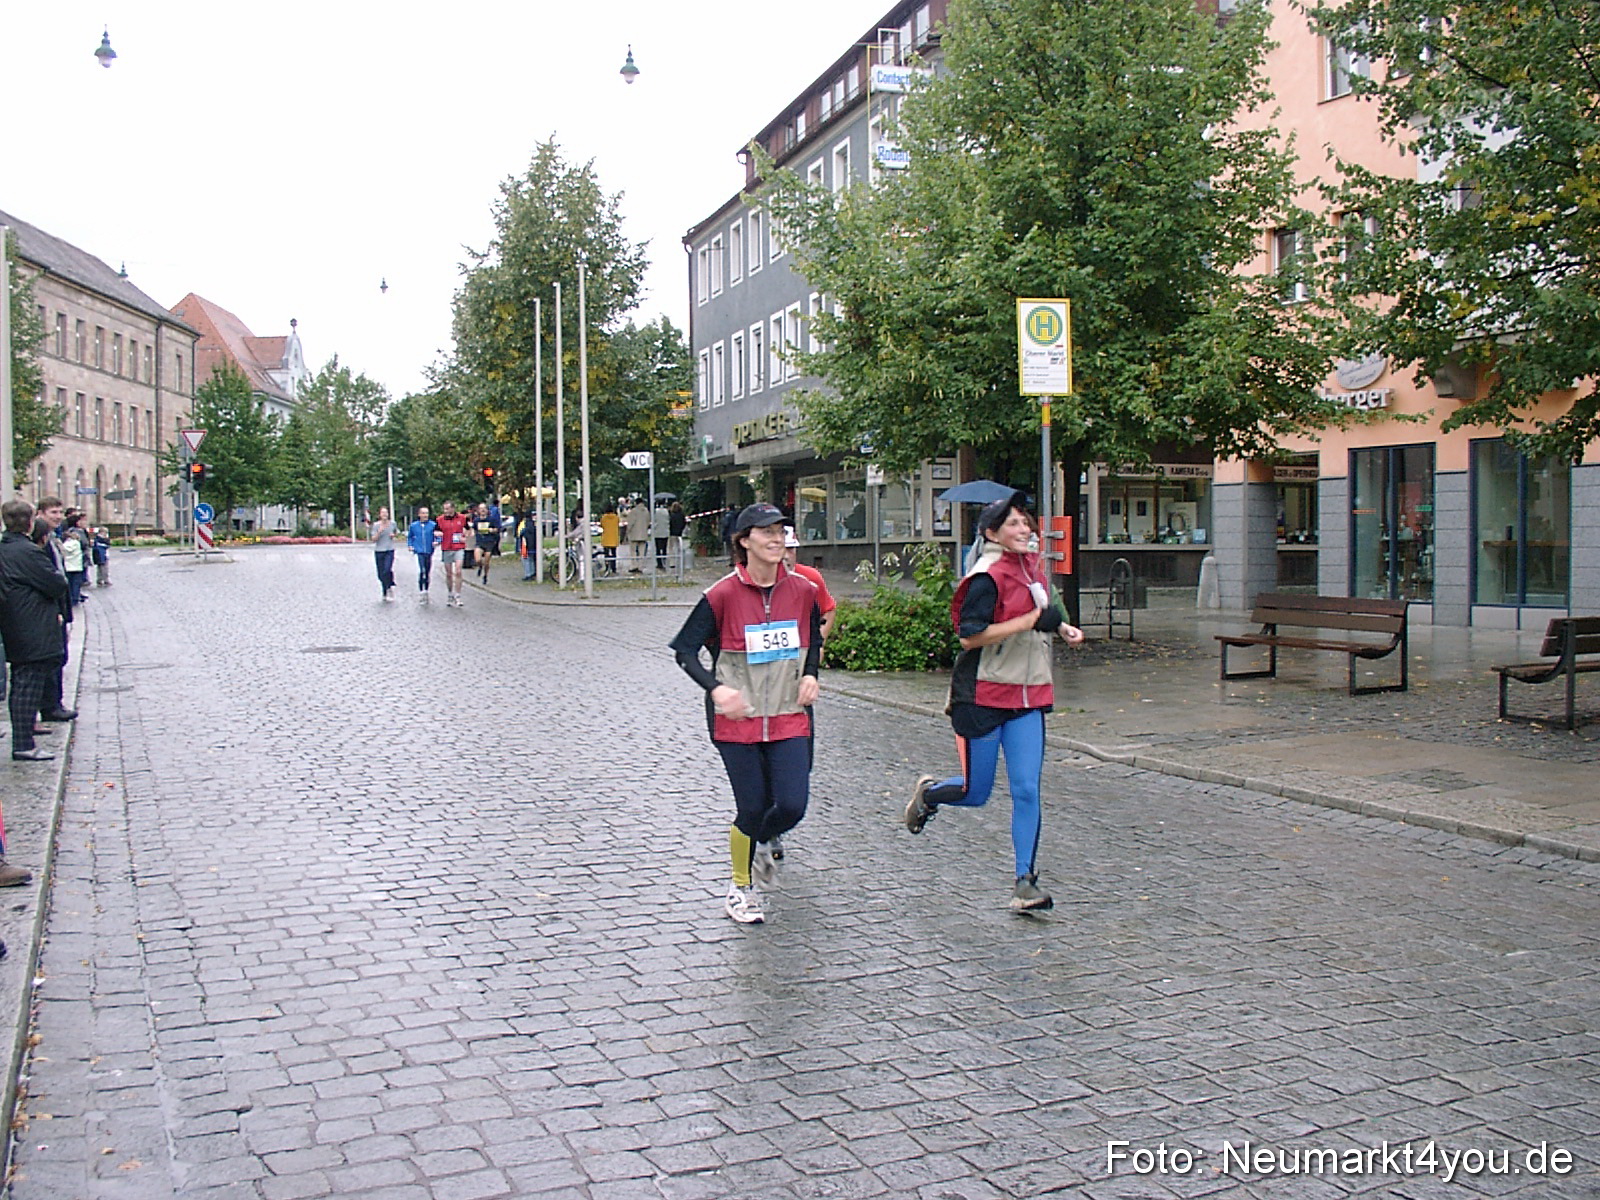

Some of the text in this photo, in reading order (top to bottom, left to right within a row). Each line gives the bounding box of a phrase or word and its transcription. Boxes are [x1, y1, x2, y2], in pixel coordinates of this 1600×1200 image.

[1036, 316, 1052, 336] H
[629, 454, 646, 467] WC
[763, 631, 789, 650] 548
